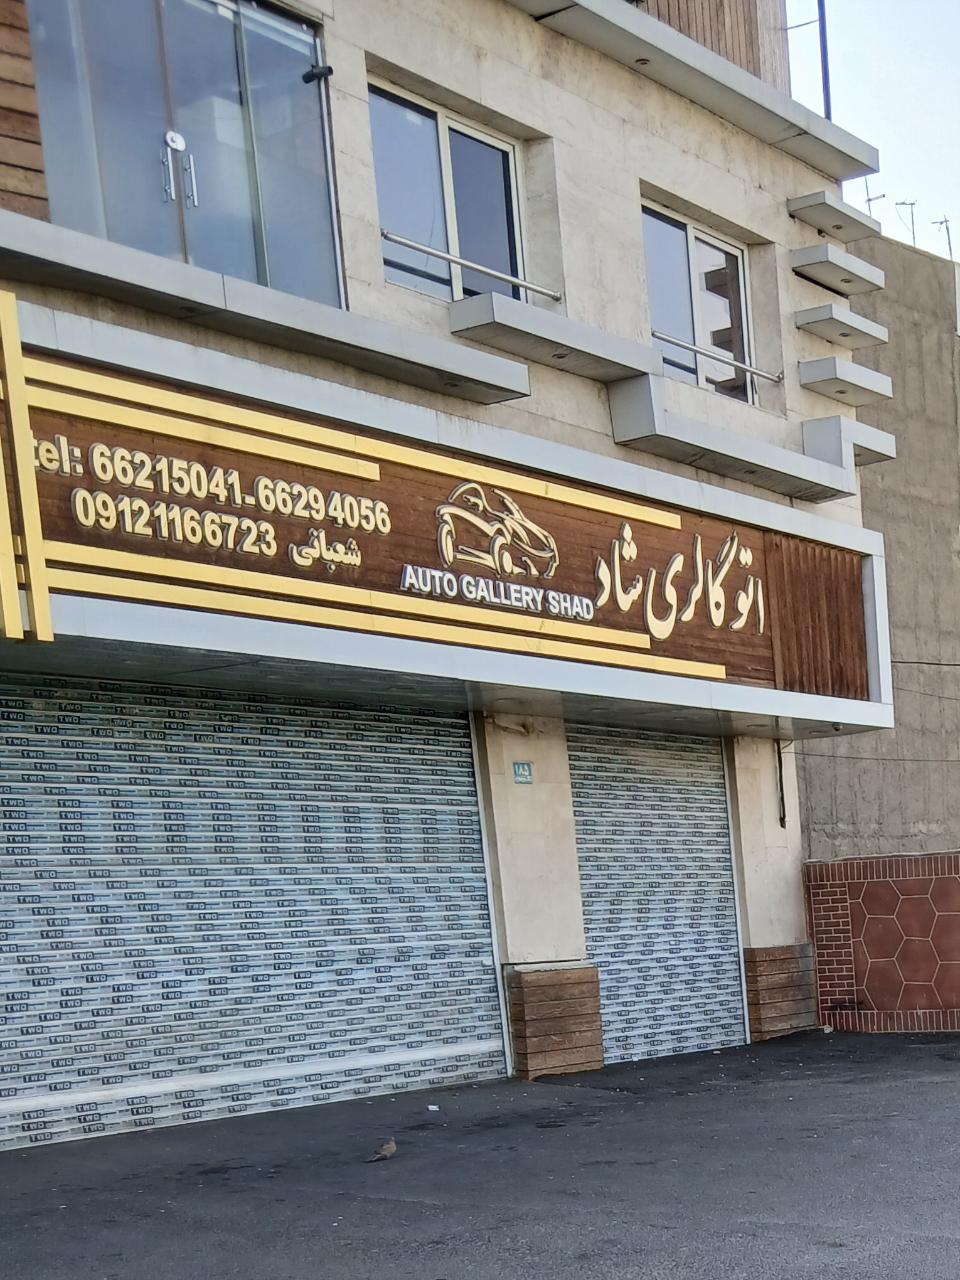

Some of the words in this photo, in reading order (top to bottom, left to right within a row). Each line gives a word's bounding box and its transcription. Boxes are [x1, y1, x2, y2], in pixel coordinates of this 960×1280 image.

[71, 488, 277, 556] 09121166723
[289, 528, 361, 573] شعبانی
[594, 521, 643, 613] شاد
[644, 530, 738, 641] گالری
[401, 564, 458, 597] AUTO
[459, 574, 544, 612] GALLERY
[545, 590, 595, 621] SHAD
[2, 712, 24, 720] TWO
[36, 726, 58, 734] TWO
[6, 737, 28, 746] TWO
[62, 740, 83, 748] TWO
[22, 750, 44, 758] TWO
[77, 752, 98, 761] TWO
[35, 763, 56, 771] TWO
[89, 765, 110, 773] TWO
[22, 774, 44, 782] TWO
[77, 776, 98, 784] TWO
[45, 787, 66, 795] TWO
[4, 823, 26, 831] TWO
[8, 835, 29, 843] TWO
[64, 835, 84, 843] TWO
[117, 835, 137, 843] TWO
[7, 847, 29, 855] TWO
[16, 859, 37, 867] TWO
[18, 895, 40, 903] TWO
[73, 894, 93, 902] TWO
[33, 907, 54, 915] TWO
[87, 905, 108, 913] TWO
[48, 918, 68, 926] TWO
[101, 916, 121, 924] TWO
[42, 930, 62, 938] TWO
[95, 927, 116, 936] TWO
[51, 941, 72, 950] TWO
[18, 955, 39, 964] TWO
[73, 952, 93, 960] TWO
[27, 966, 48, 975] TWO
[82, 963, 102, 971] TWO
[33, 978, 54, 986] TWO
[7, 992, 28, 1000] TWO
[6, 1003, 27, 1012] TWO
[60, 999, 81, 1008] TWO
[40, 1012, 60, 1021] TWO
[21, 1049, 42, 1059] TWO
[24, 1073, 45, 1082] TWO
[50, 1081, 70, 1091] TWO
[23, 1110, 44, 1119] TWO
[132, 1106, 152, 1115] TWO
[79, 1113, 100, 1123] TWO
[23, 1121, 44, 1131] TWO
